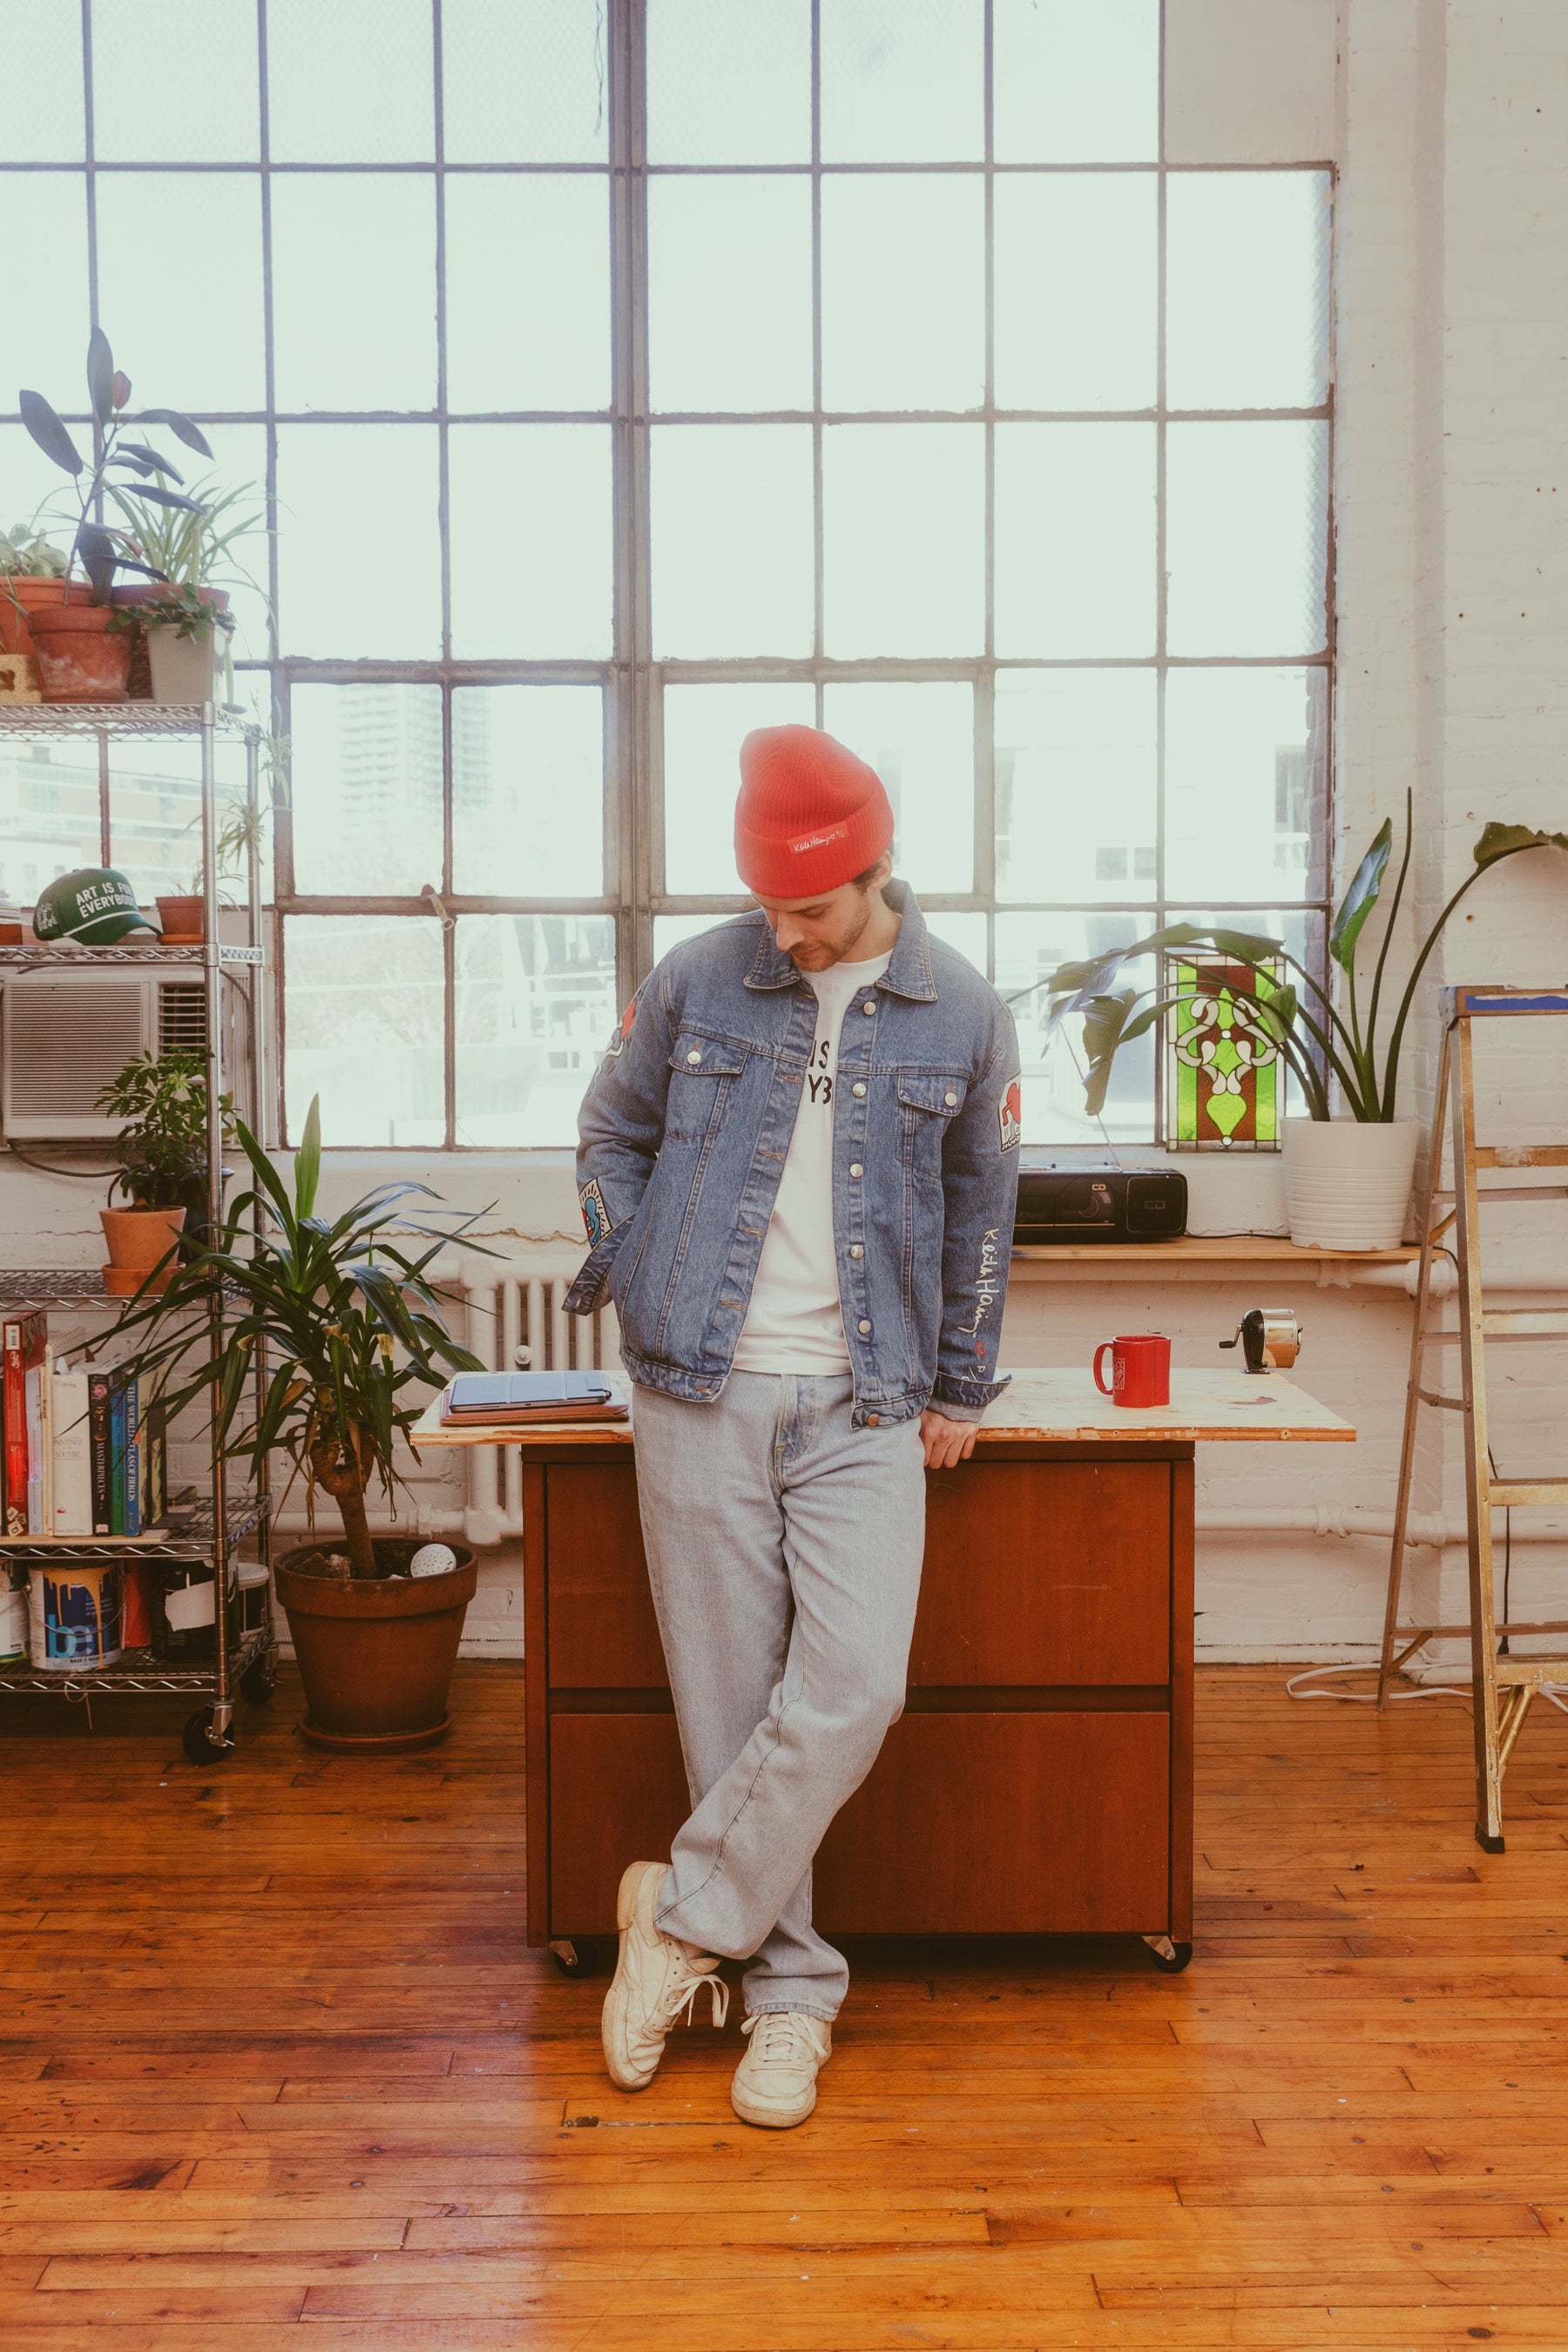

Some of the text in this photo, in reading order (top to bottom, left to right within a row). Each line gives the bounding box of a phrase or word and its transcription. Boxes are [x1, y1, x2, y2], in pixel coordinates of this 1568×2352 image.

[76, 885, 98, 906] ART
[101, 882, 115, 894] IS
[78, 894, 135, 918] EVERYBOD
[810, 1040, 830, 1069] IS
[975, 1227, 1000, 1280] Keith
[127, 1385, 136, 1403] THE
[127, 1404, 136, 1437] WORLD
[97, 1443, 105, 1494] MASTERPIECES
[128, 1463, 136, 1476] OF
[128, 1477, 137, 1502] BIRDS
